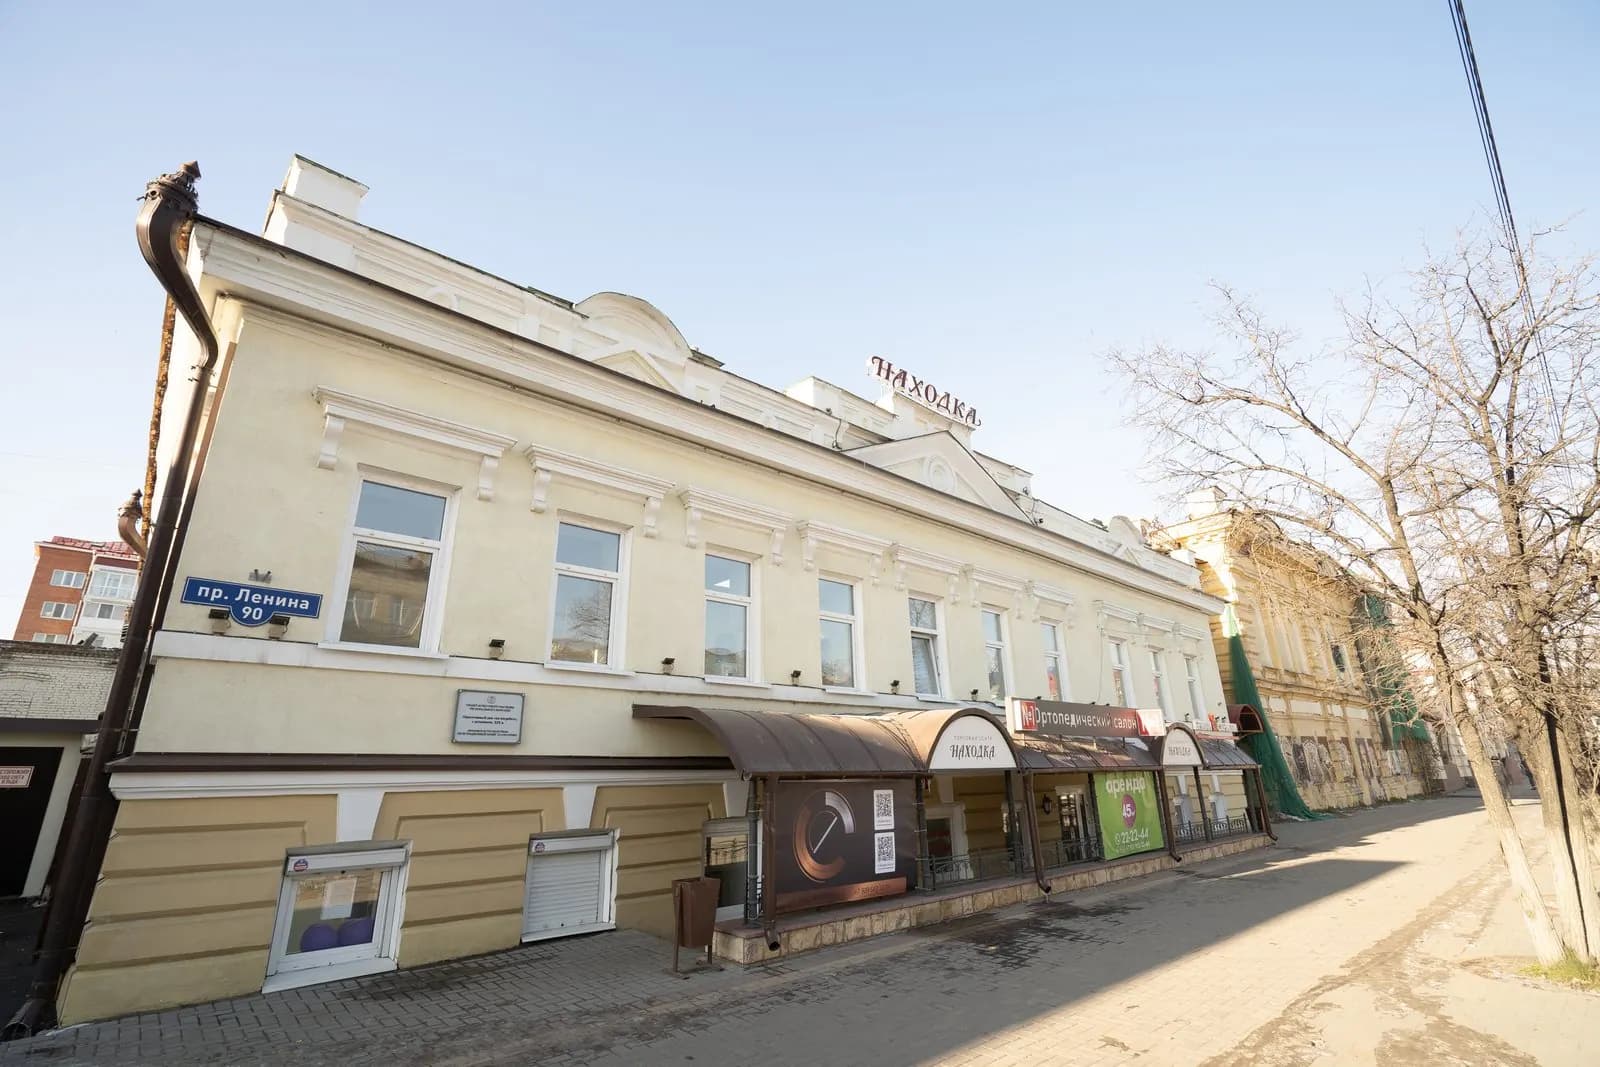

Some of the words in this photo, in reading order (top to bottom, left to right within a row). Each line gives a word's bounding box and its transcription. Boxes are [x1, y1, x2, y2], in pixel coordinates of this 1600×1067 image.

[871, 355, 982, 427] НАХОДКА
[197, 586, 229, 601] пр.
[234, 589, 310, 610] Ленина
[241, 606, 263, 620] 90
[1113, 716, 1137, 729] салон
[949, 744, 995, 761] НАХОДКА
[1106, 777, 1145, 798] аренда
